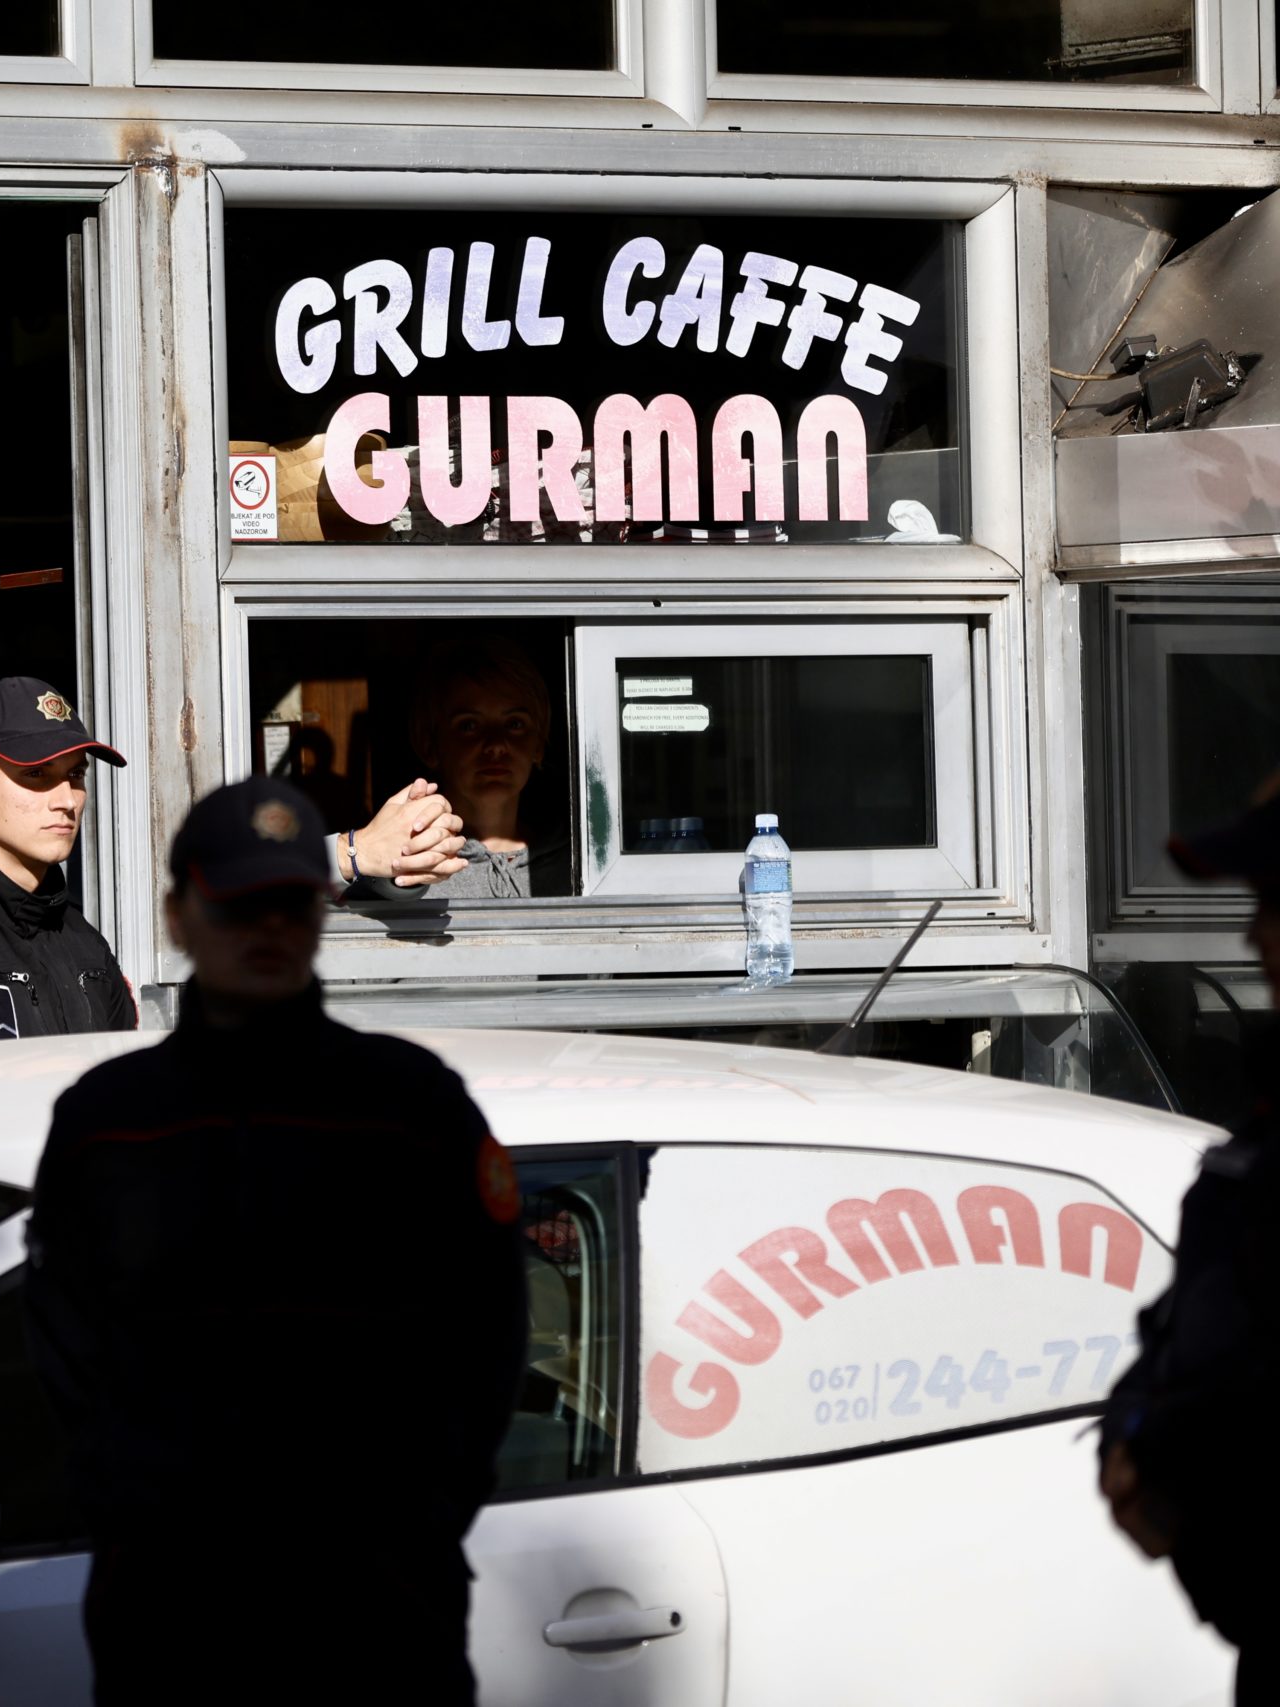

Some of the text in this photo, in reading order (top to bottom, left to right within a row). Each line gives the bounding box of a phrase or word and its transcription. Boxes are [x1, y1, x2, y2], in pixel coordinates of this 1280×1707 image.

[275, 237, 920, 395] GRILL CAFFE
[324, 393, 869, 525] GURMAN
[645, 1185, 1142, 1440] GURMAN
[808, 1364, 862, 1394] 067
[814, 1396, 870, 1425] 020
[885, 1332, 1142, 1417] 244-77
